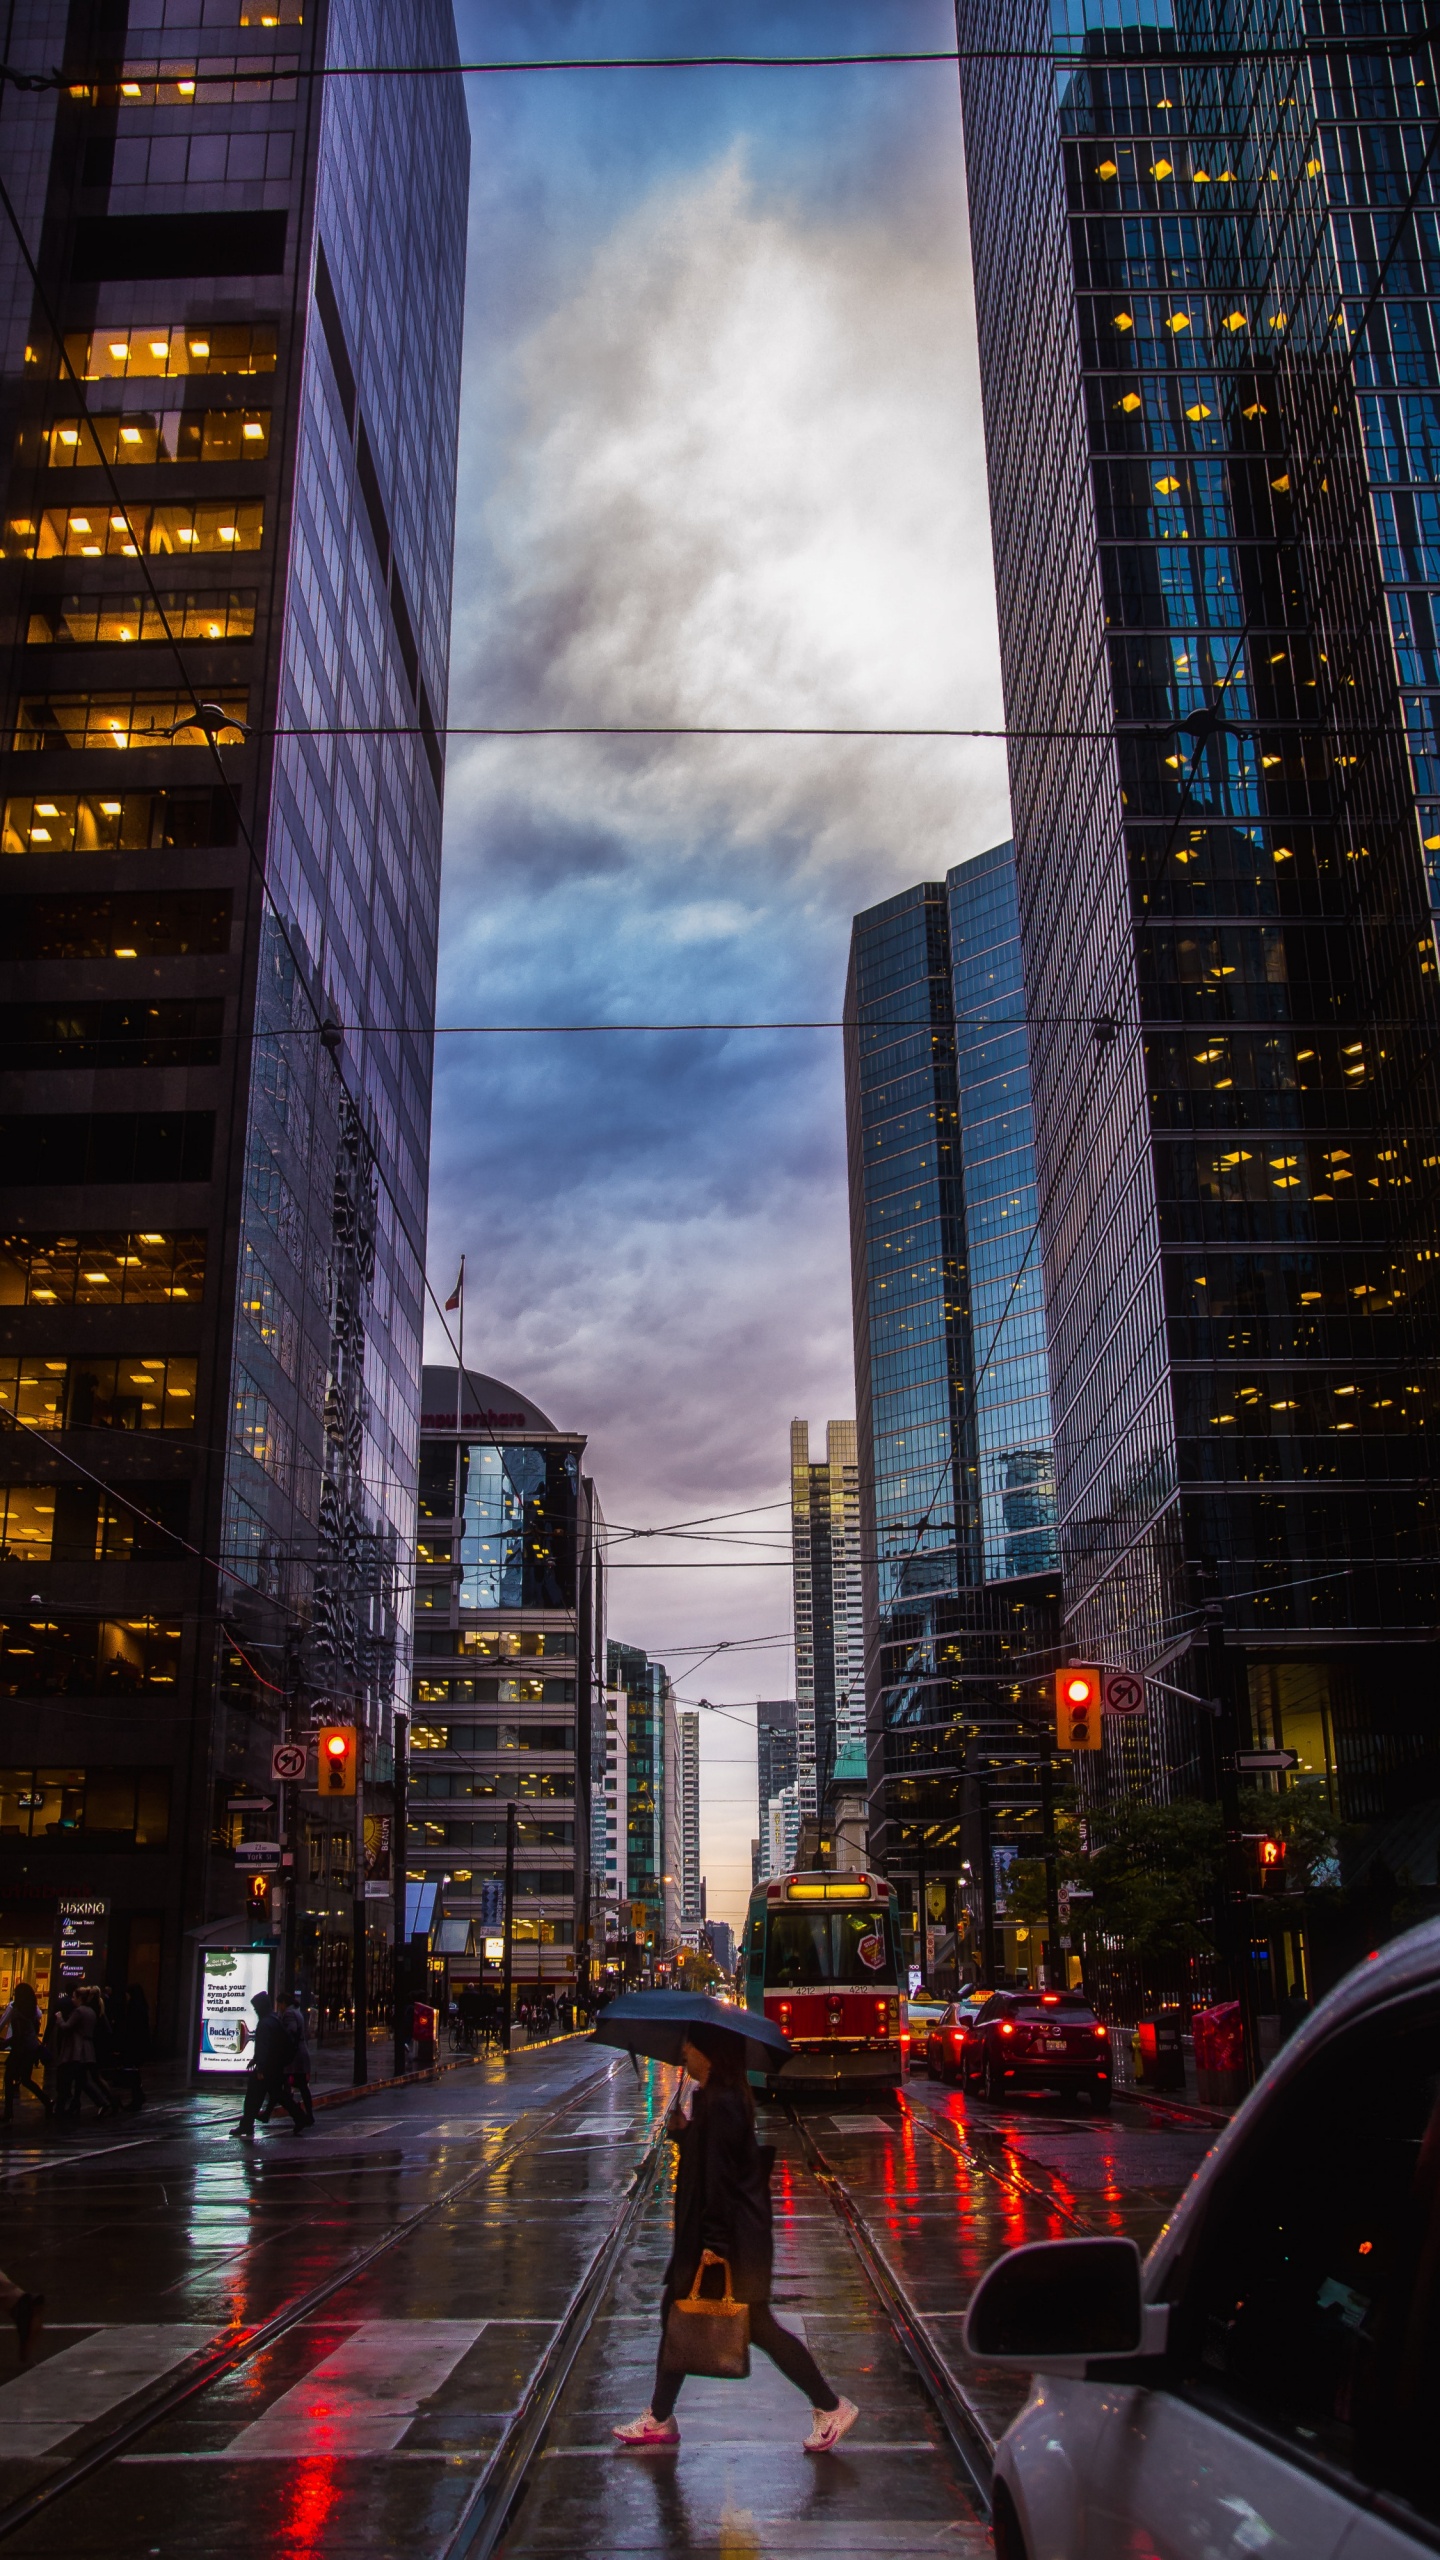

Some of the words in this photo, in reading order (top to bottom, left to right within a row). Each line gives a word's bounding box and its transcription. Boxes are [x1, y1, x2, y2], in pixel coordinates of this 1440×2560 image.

[421, 1409, 525, 1428] mpuershare
[381, 1817, 390, 1851] BEAUTY
[247, 1853, 263, 1861] York
[796, 1986, 815, 1995] 4212
[849, 1985, 868, 1994] 4212
[209, 2027, 239, 2038] Buckley's
